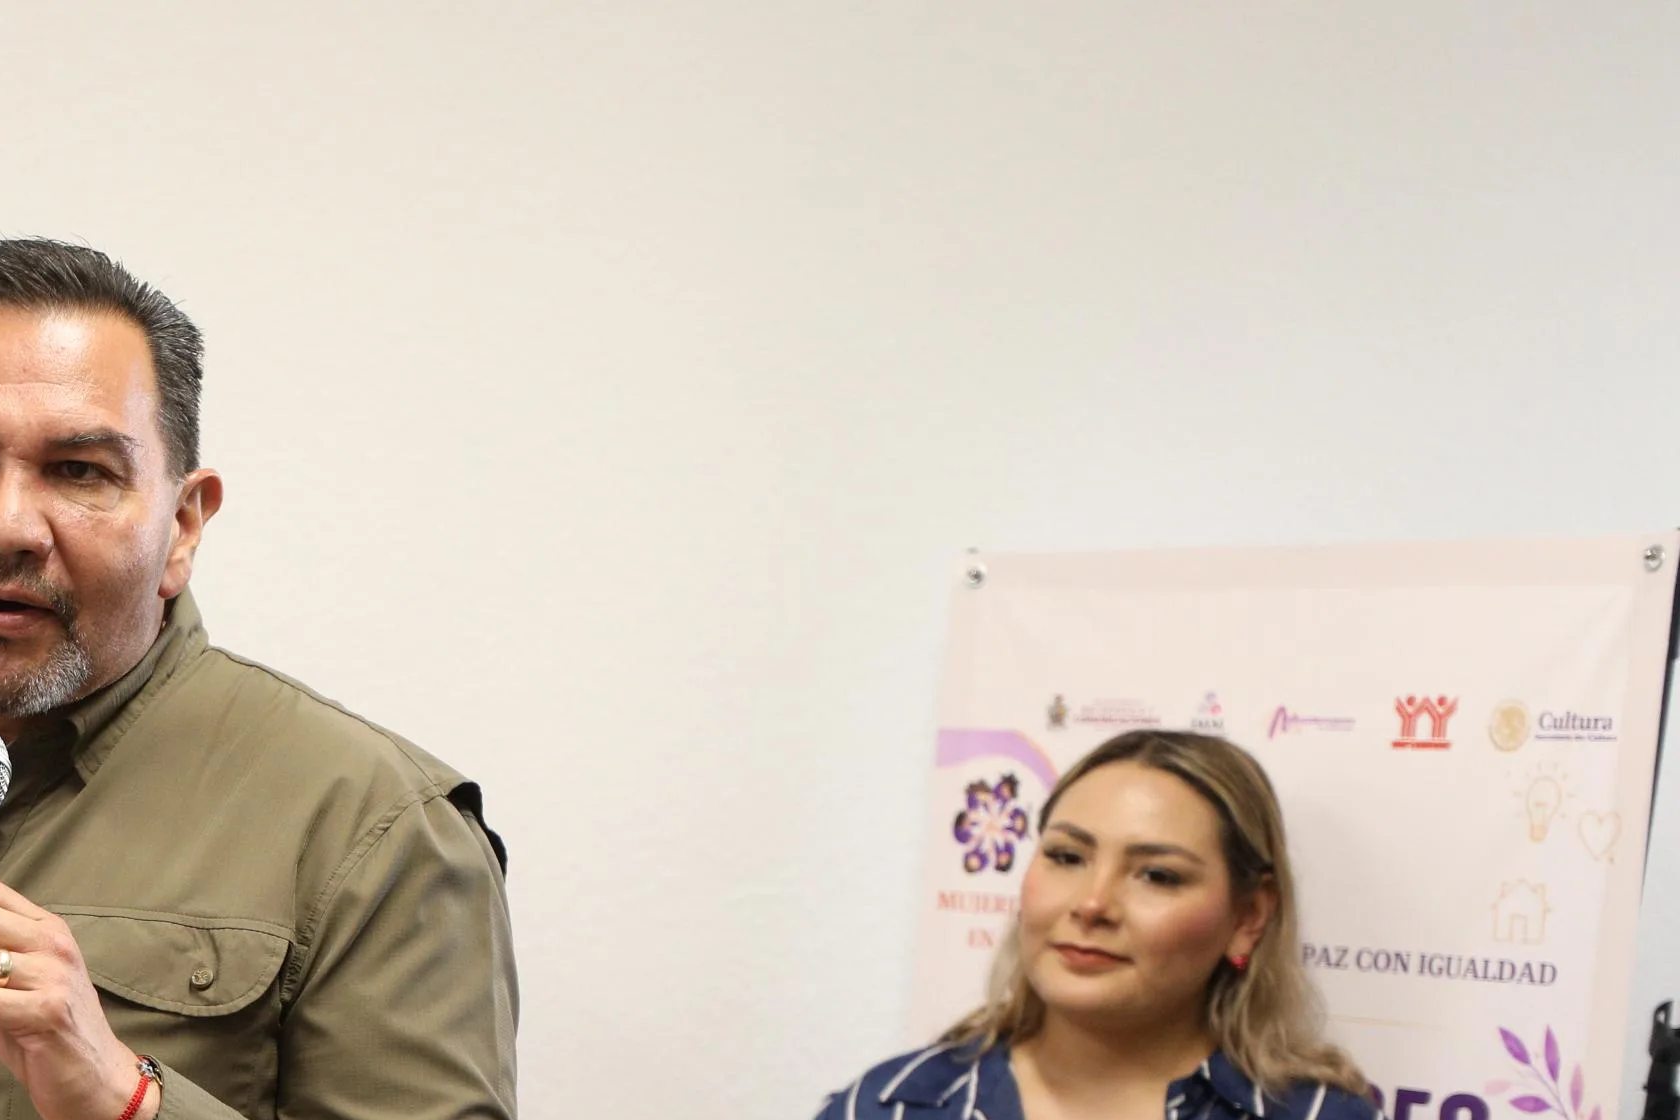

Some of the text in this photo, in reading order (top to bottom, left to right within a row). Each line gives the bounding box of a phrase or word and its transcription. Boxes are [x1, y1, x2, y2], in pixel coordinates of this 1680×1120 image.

[1538, 710, 1613, 731] Cultura
[1301, 943, 1558, 987] PAZ CON IGUALDAD
